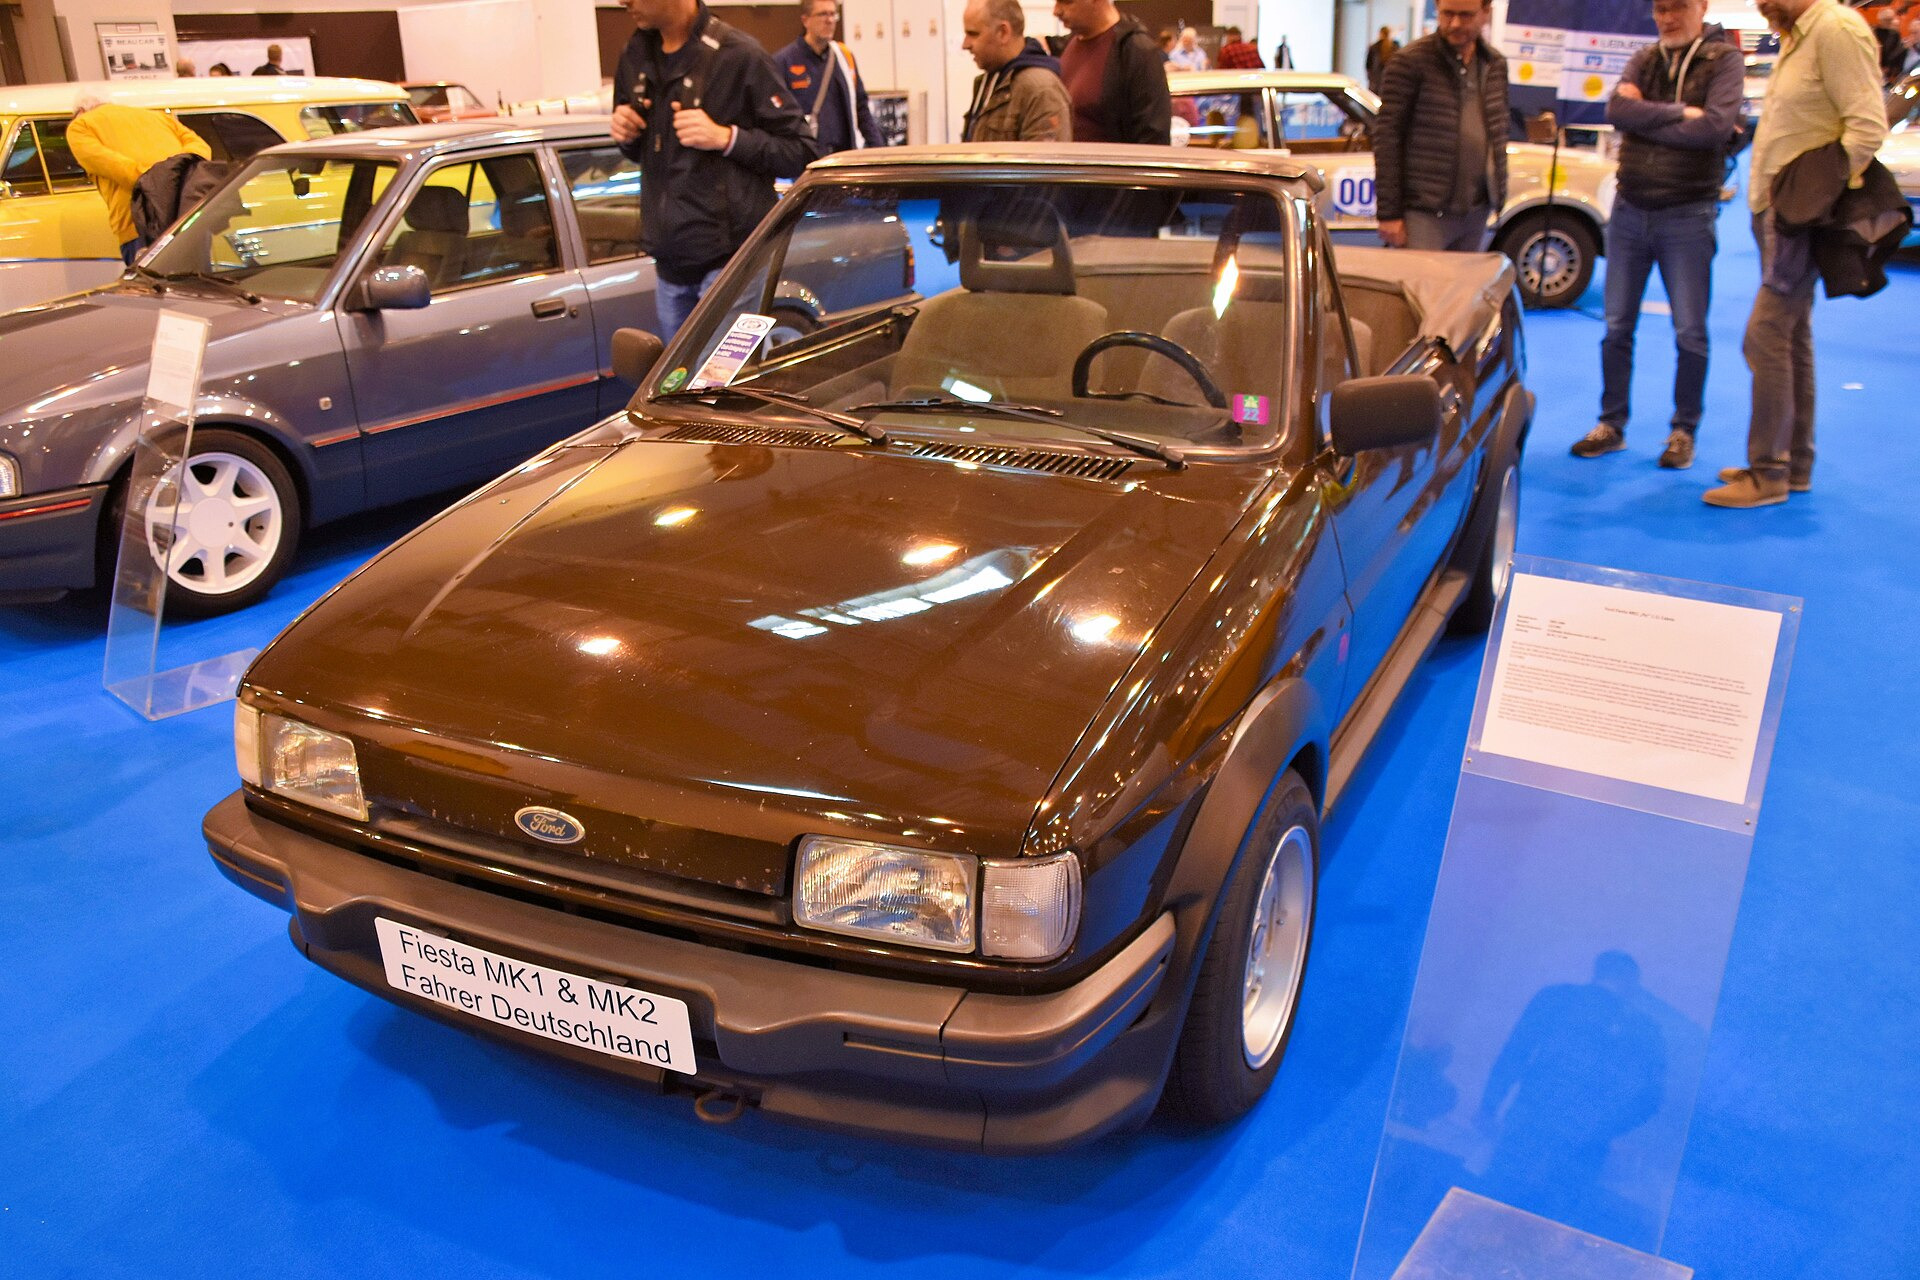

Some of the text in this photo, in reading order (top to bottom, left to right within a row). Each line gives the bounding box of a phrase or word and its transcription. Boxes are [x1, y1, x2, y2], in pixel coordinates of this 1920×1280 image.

[1243, 407, 1259, 421] 22
[530, 813, 566, 837] Ford
[399, 929, 658, 1025] Fiesta MK1 & MK2
[401, 963, 672, 1065] Fahrer Deutschland
